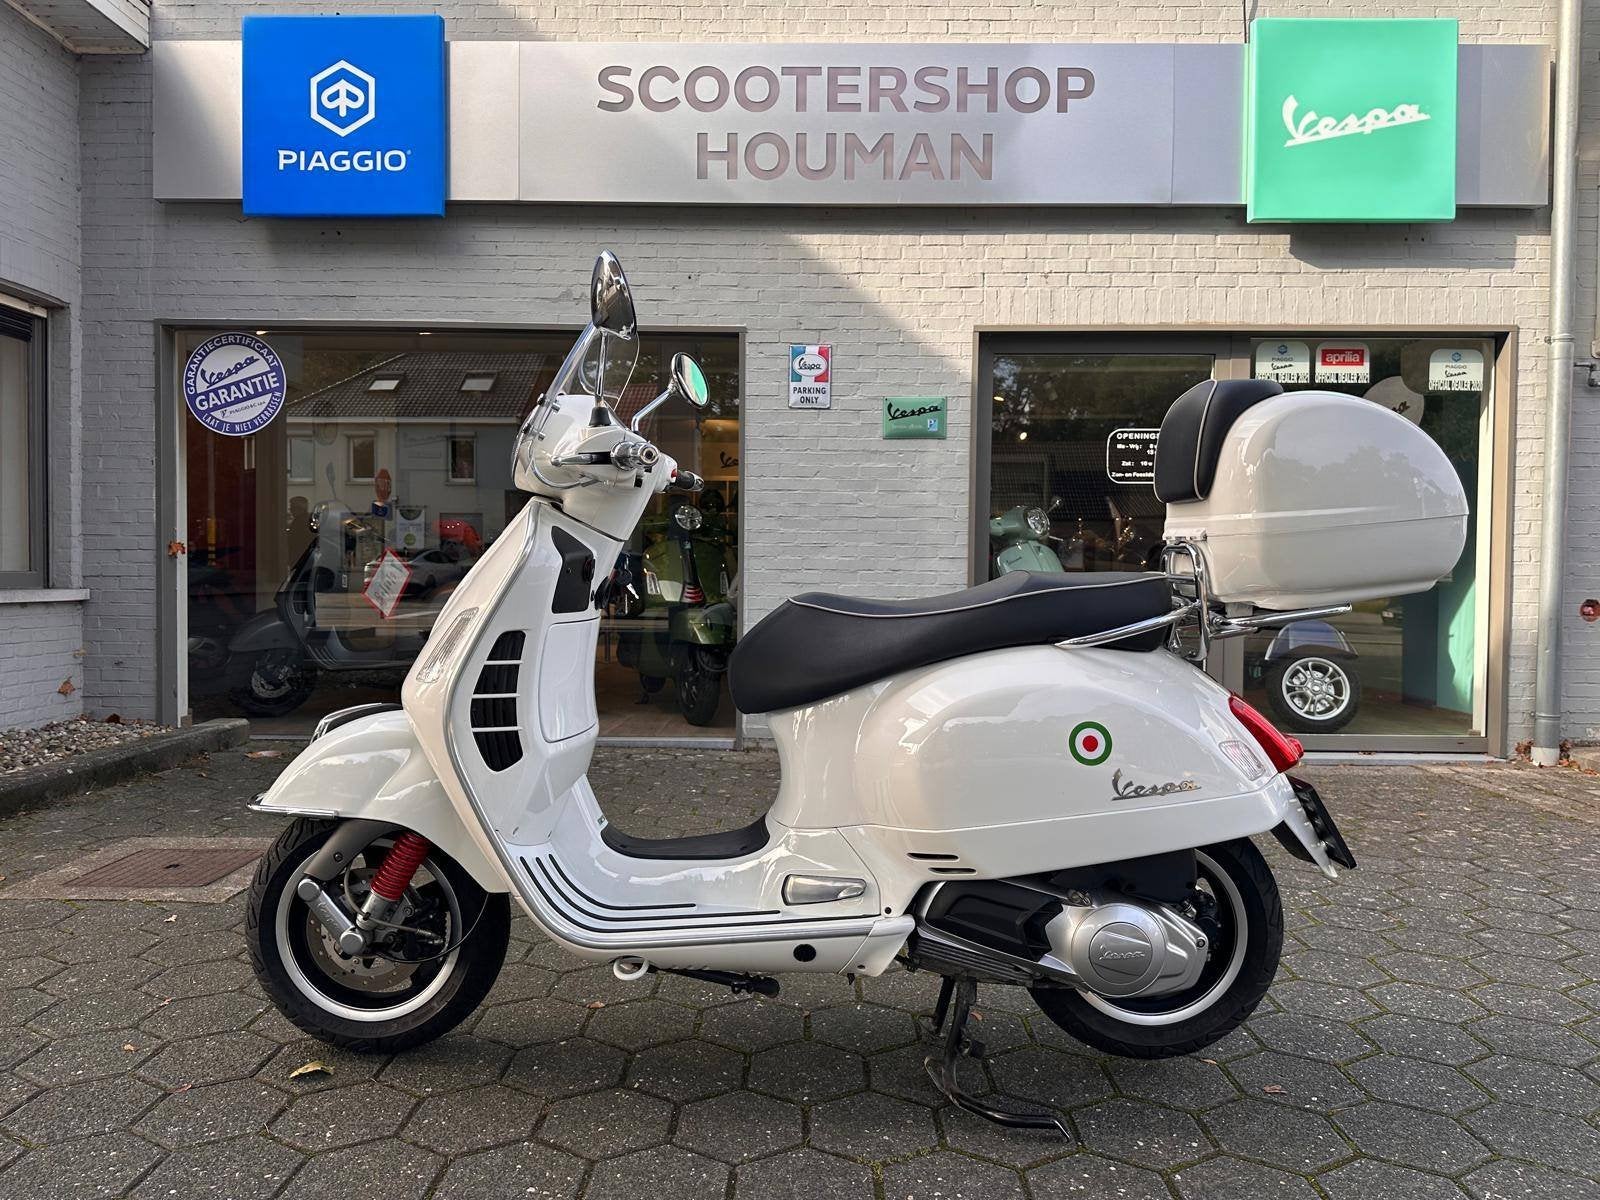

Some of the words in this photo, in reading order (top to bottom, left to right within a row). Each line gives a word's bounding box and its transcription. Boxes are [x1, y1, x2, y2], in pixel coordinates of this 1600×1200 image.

[597, 65, 1096, 113] SCOOTERSHOP
[1281, 95, 1431, 148] Vespa
[277, 150, 407, 172] PIAGGIO
[696, 132, 993, 182] HOUMAN
[798, 357, 822, 371] Vespa
[1325, 351, 1360, 364] aprilia
[200, 355, 260, 389] Vespa
[1315, 373, 1337, 383] OFFICIAL
[1338, 373, 1357, 383] DEALER
[195, 372, 280, 411] GARANTIE
[792, 386, 827, 395] PARKING
[1429, 380, 1451, 390] OFFICIAL
[1452, 380, 1470, 391] DEALER
[799, 396, 819, 404] ONLY
[202, 413, 219, 429] LAAT
[222, 423, 232, 433] JE
[235, 421, 252, 433] NIET
[254, 392, 282, 427] VERRASSEN
[887, 402, 941, 421] Vespa
[1111, 768, 1202, 801] Vespa
